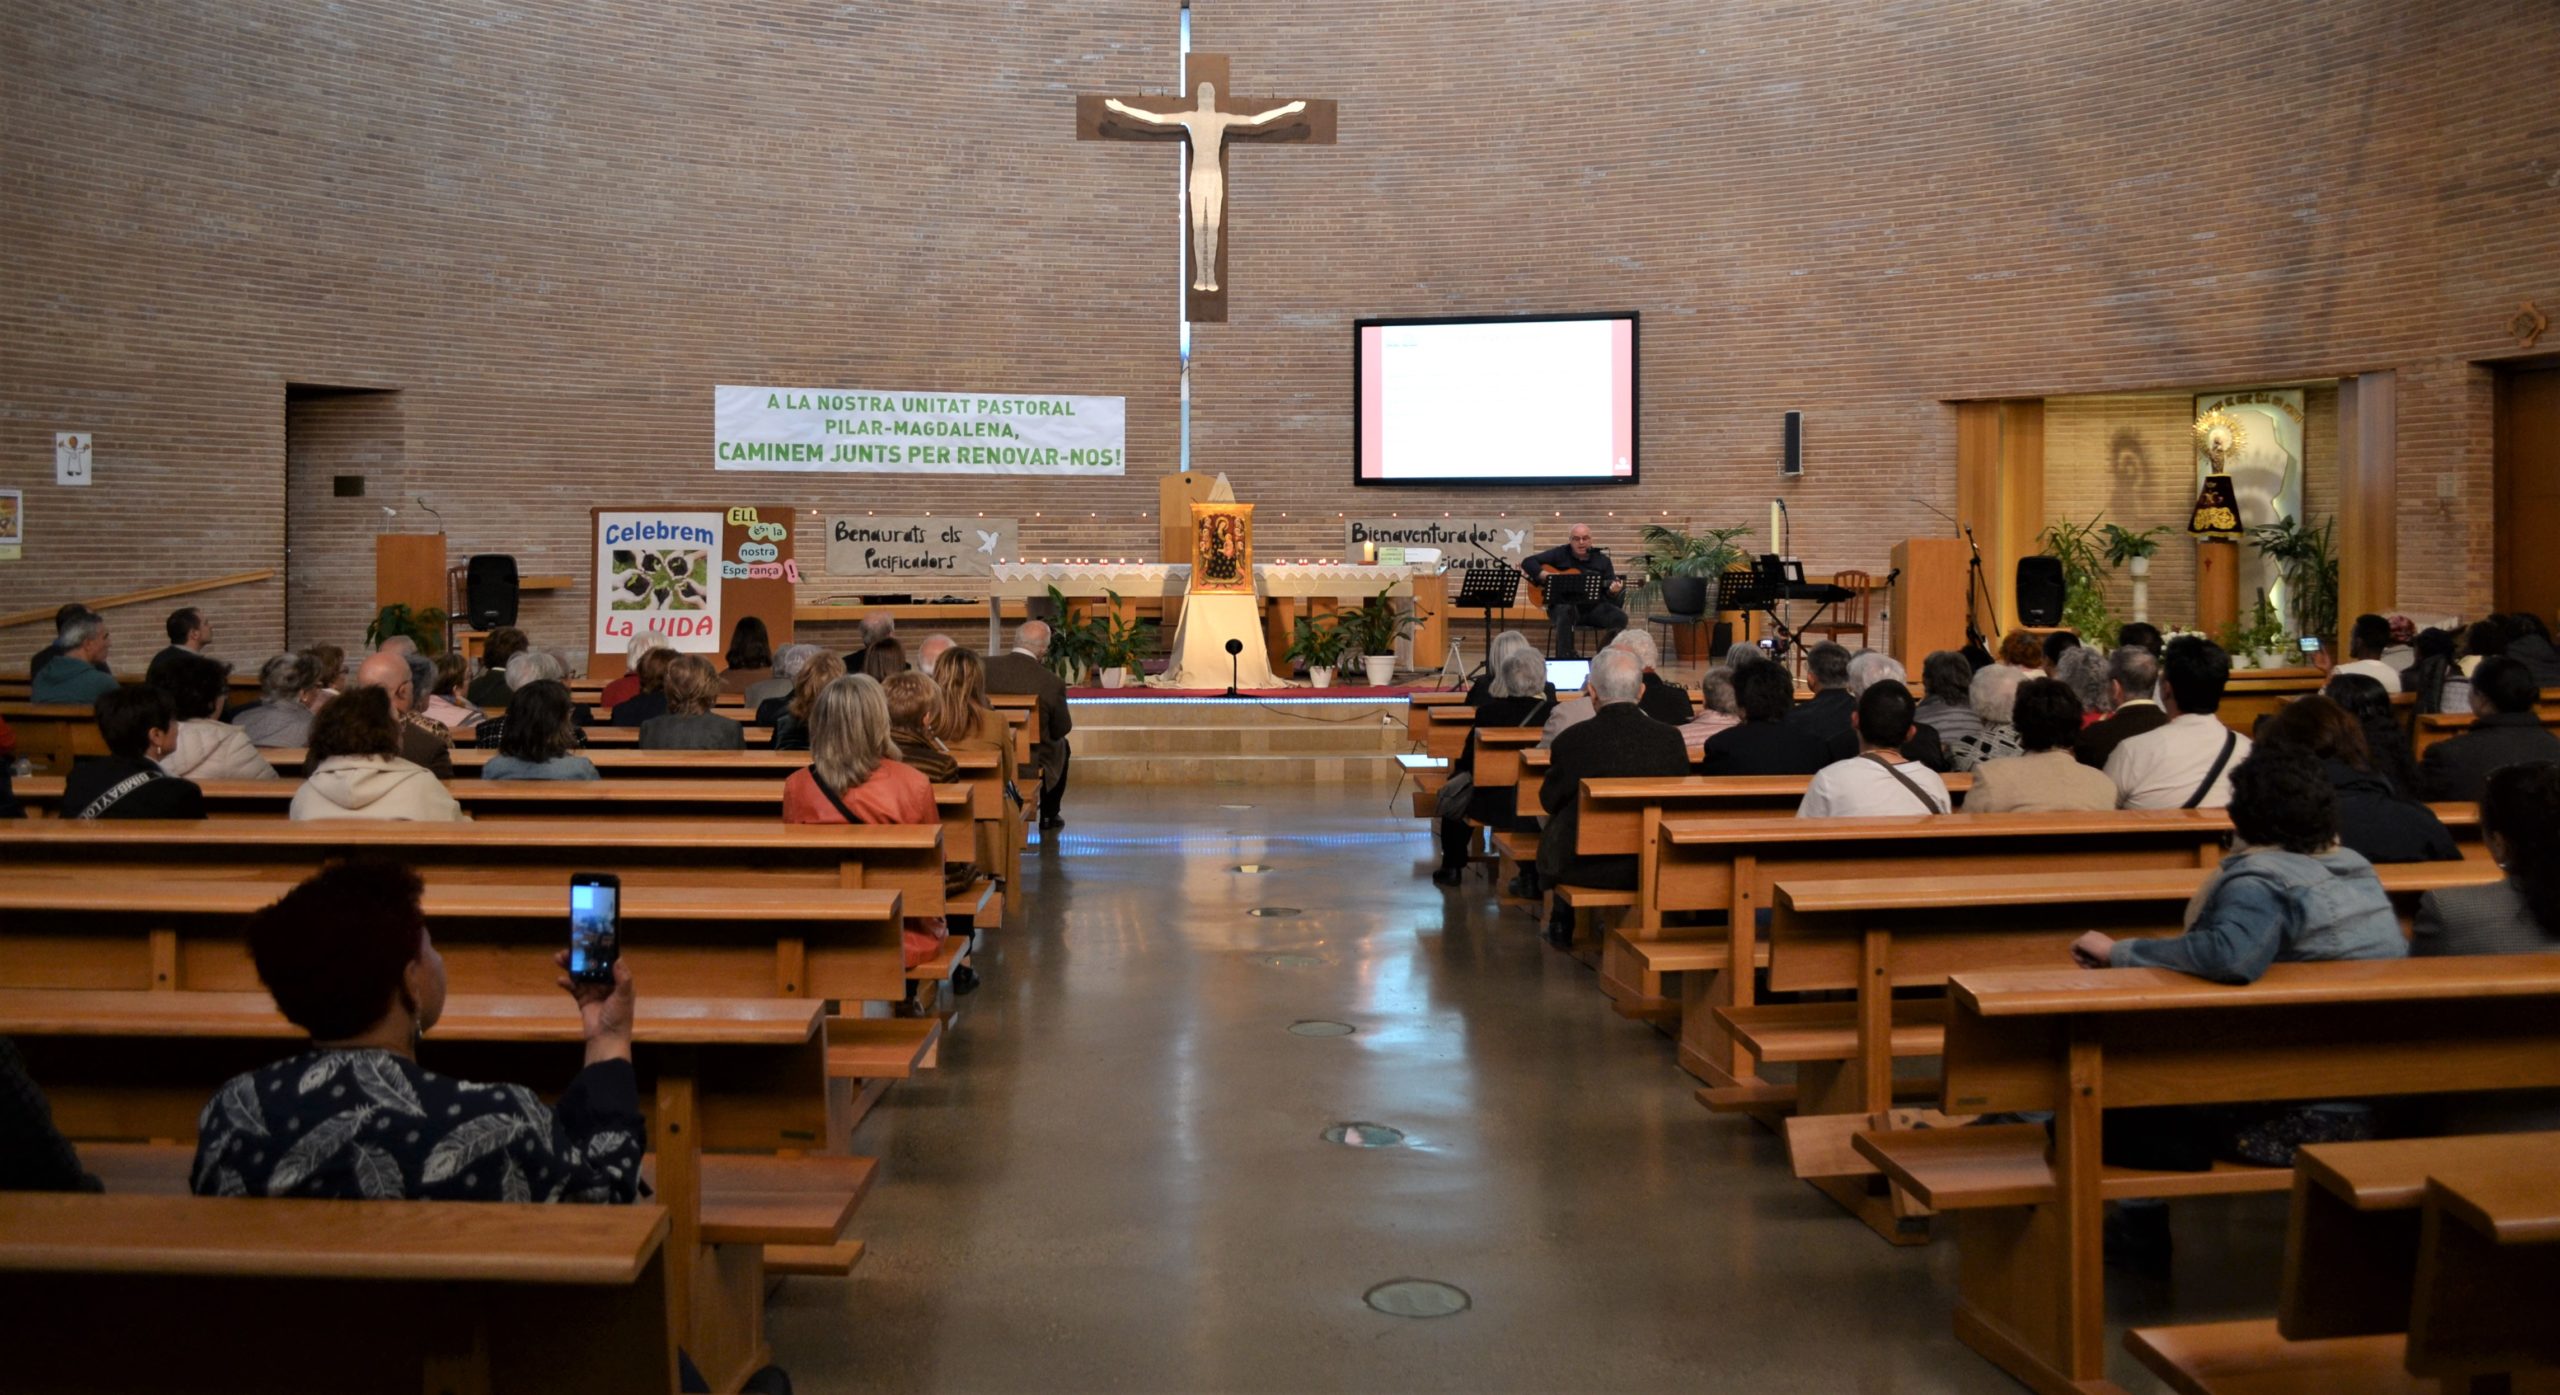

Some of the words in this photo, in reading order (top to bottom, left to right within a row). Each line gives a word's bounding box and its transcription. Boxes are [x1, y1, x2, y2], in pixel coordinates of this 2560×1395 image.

[767, 393, 780, 409] A
[786, 394, 811, 410] LA
[817, 396, 896, 413] NOSTRA
[902, 397, 971, 414] UNITAT
[977, 400, 1076, 417] PASTORAL
[825, 419, 1020, 440] PILAR-MAGDALENA,
[718, 441, 824, 463] CAMINEM
[830, 444, 902, 464] JUNTS
[907, 445, 951, 465] PER
[956, 446, 1122, 468] RENOVAR-NOS!
[733, 509, 756, 522] ELL
[606, 520, 714, 546] Celebrem
[773, 526, 783, 536] la
[835, 520, 925, 544] Benaurats
[941, 525, 963, 543] els
[1351, 522, 1498, 544] Bienaventurados
[741, 548, 776, 557] nostra
[865, 547, 958, 573] Pacificadors
[723, 565, 779, 577] Esperança
[605, 616, 633, 637] La
[649, 616, 714, 637] VIDA
